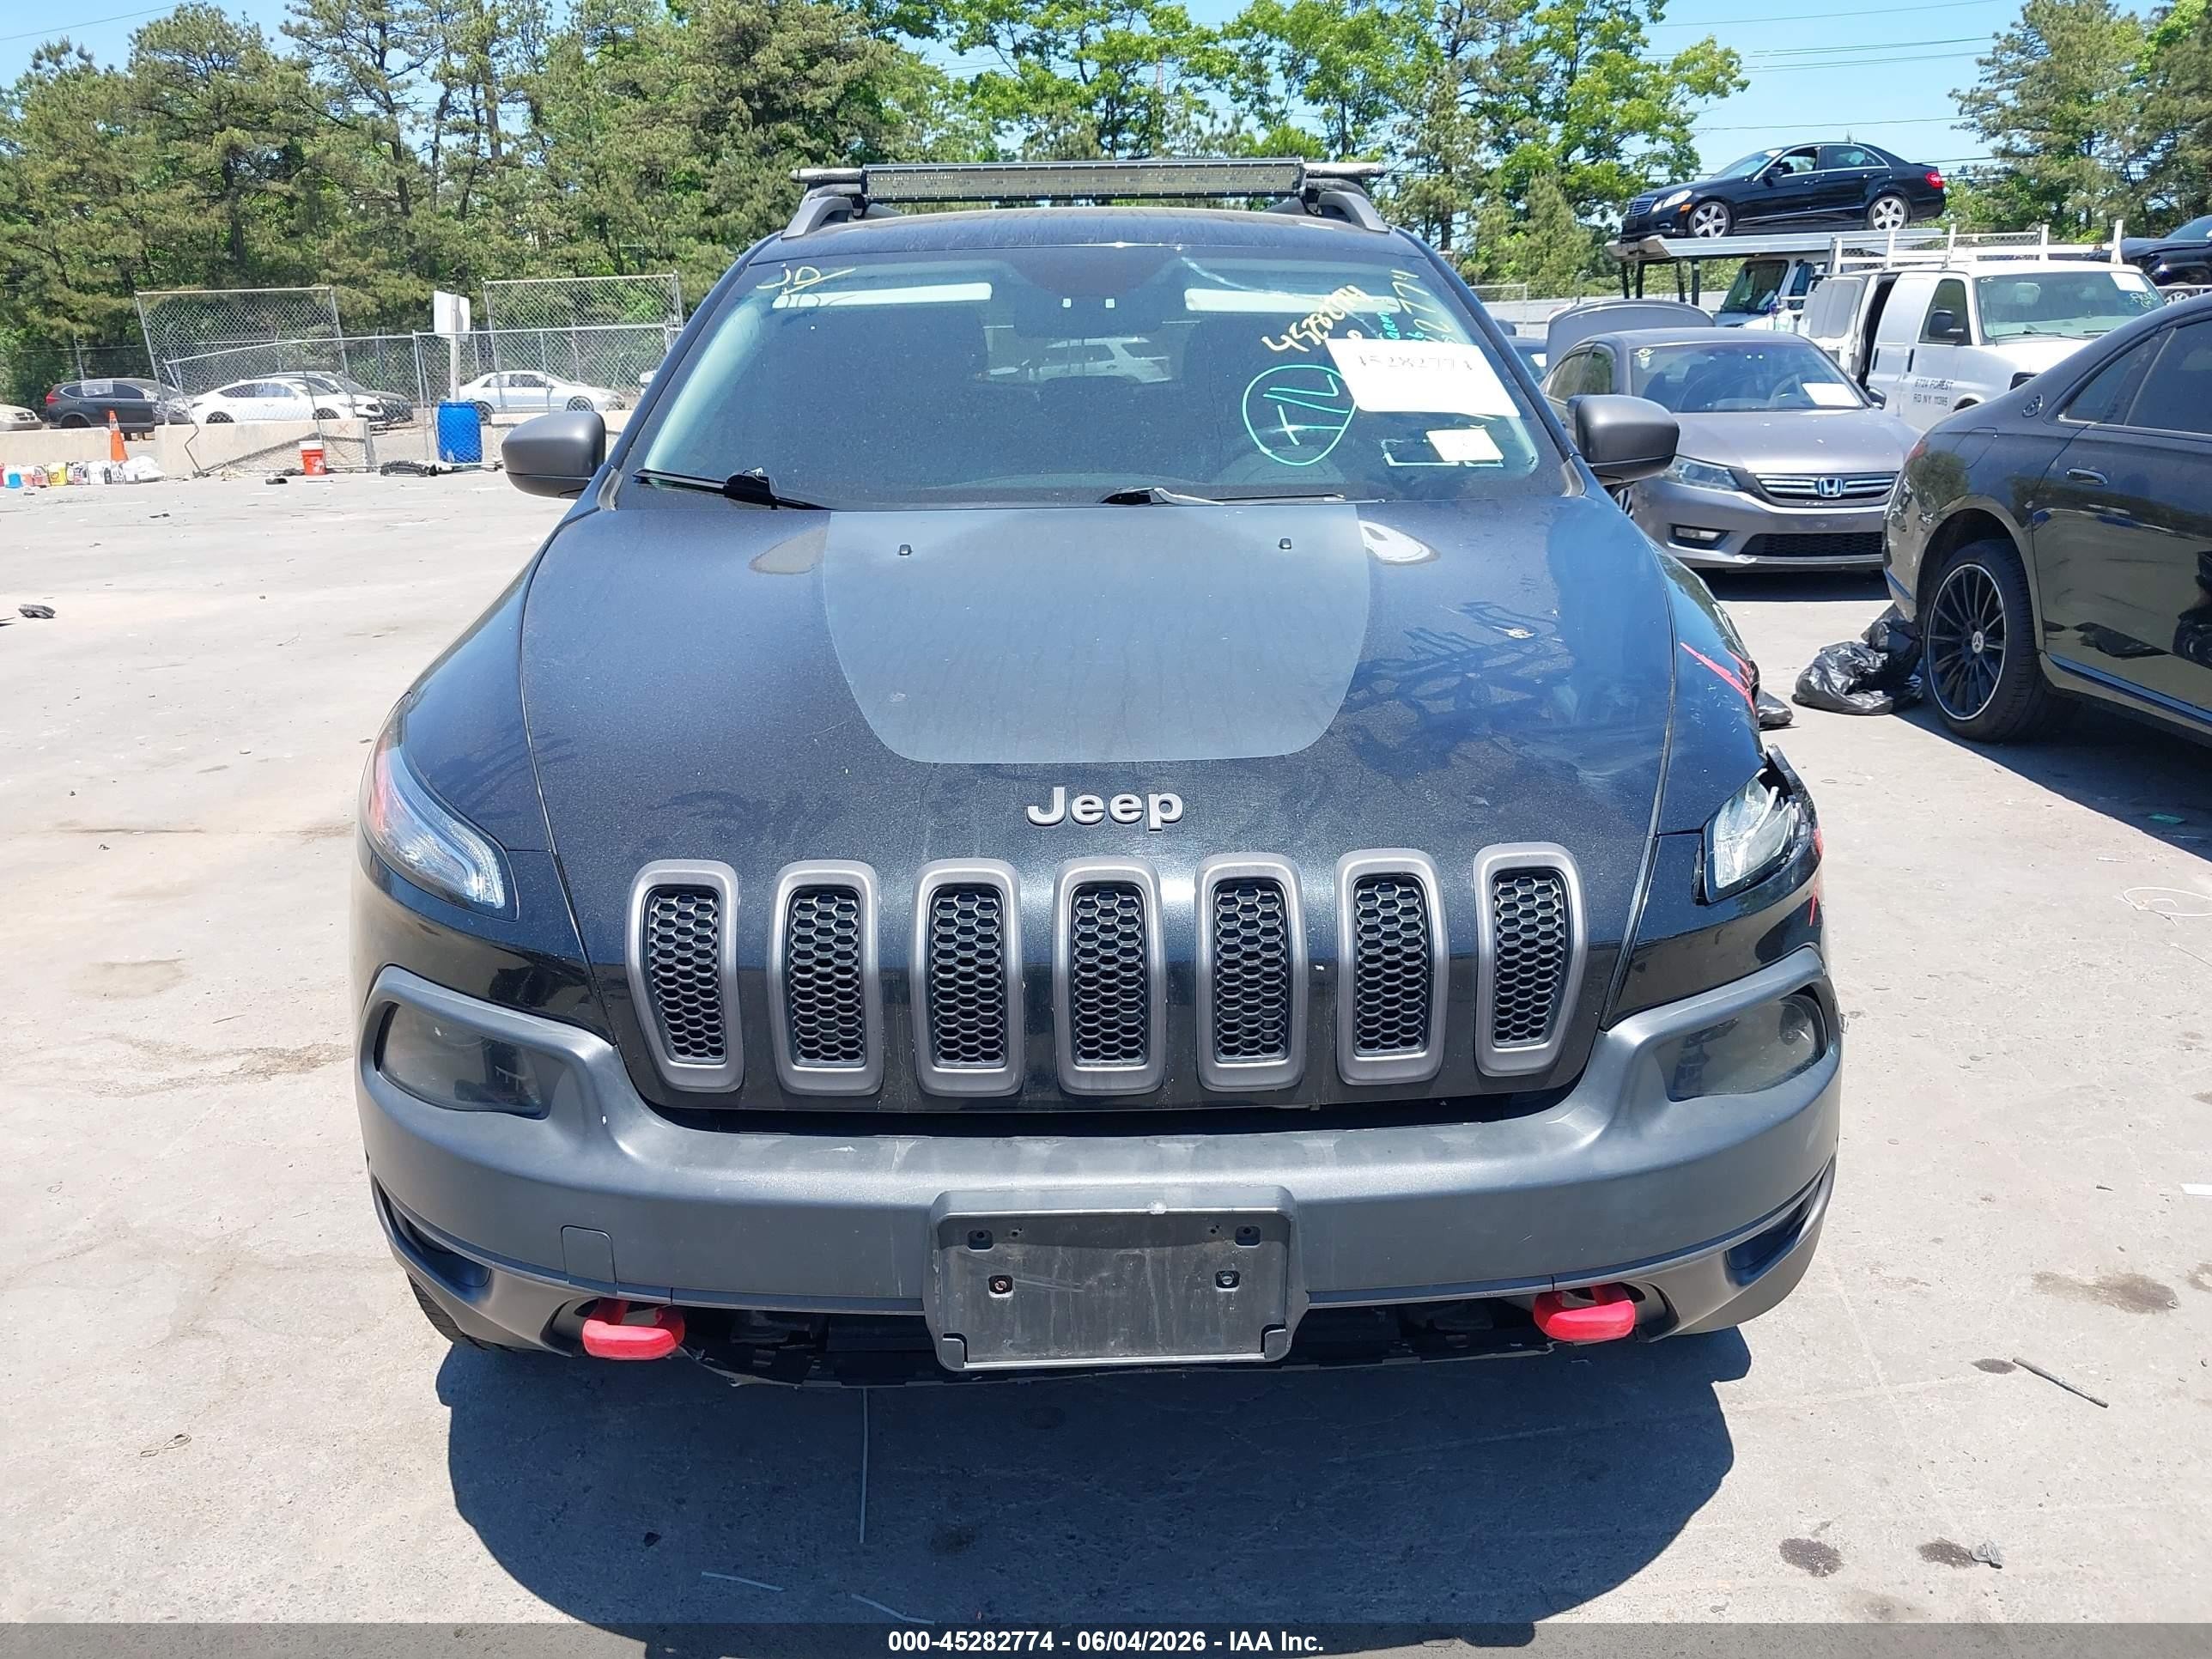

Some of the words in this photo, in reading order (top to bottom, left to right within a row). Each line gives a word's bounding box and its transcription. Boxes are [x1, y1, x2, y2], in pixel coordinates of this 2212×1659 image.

[1929, 380, 1954, 391] FOREST
[1923, 395, 1932, 404] NY
[1027, 787, 1183, 831] Jeep
